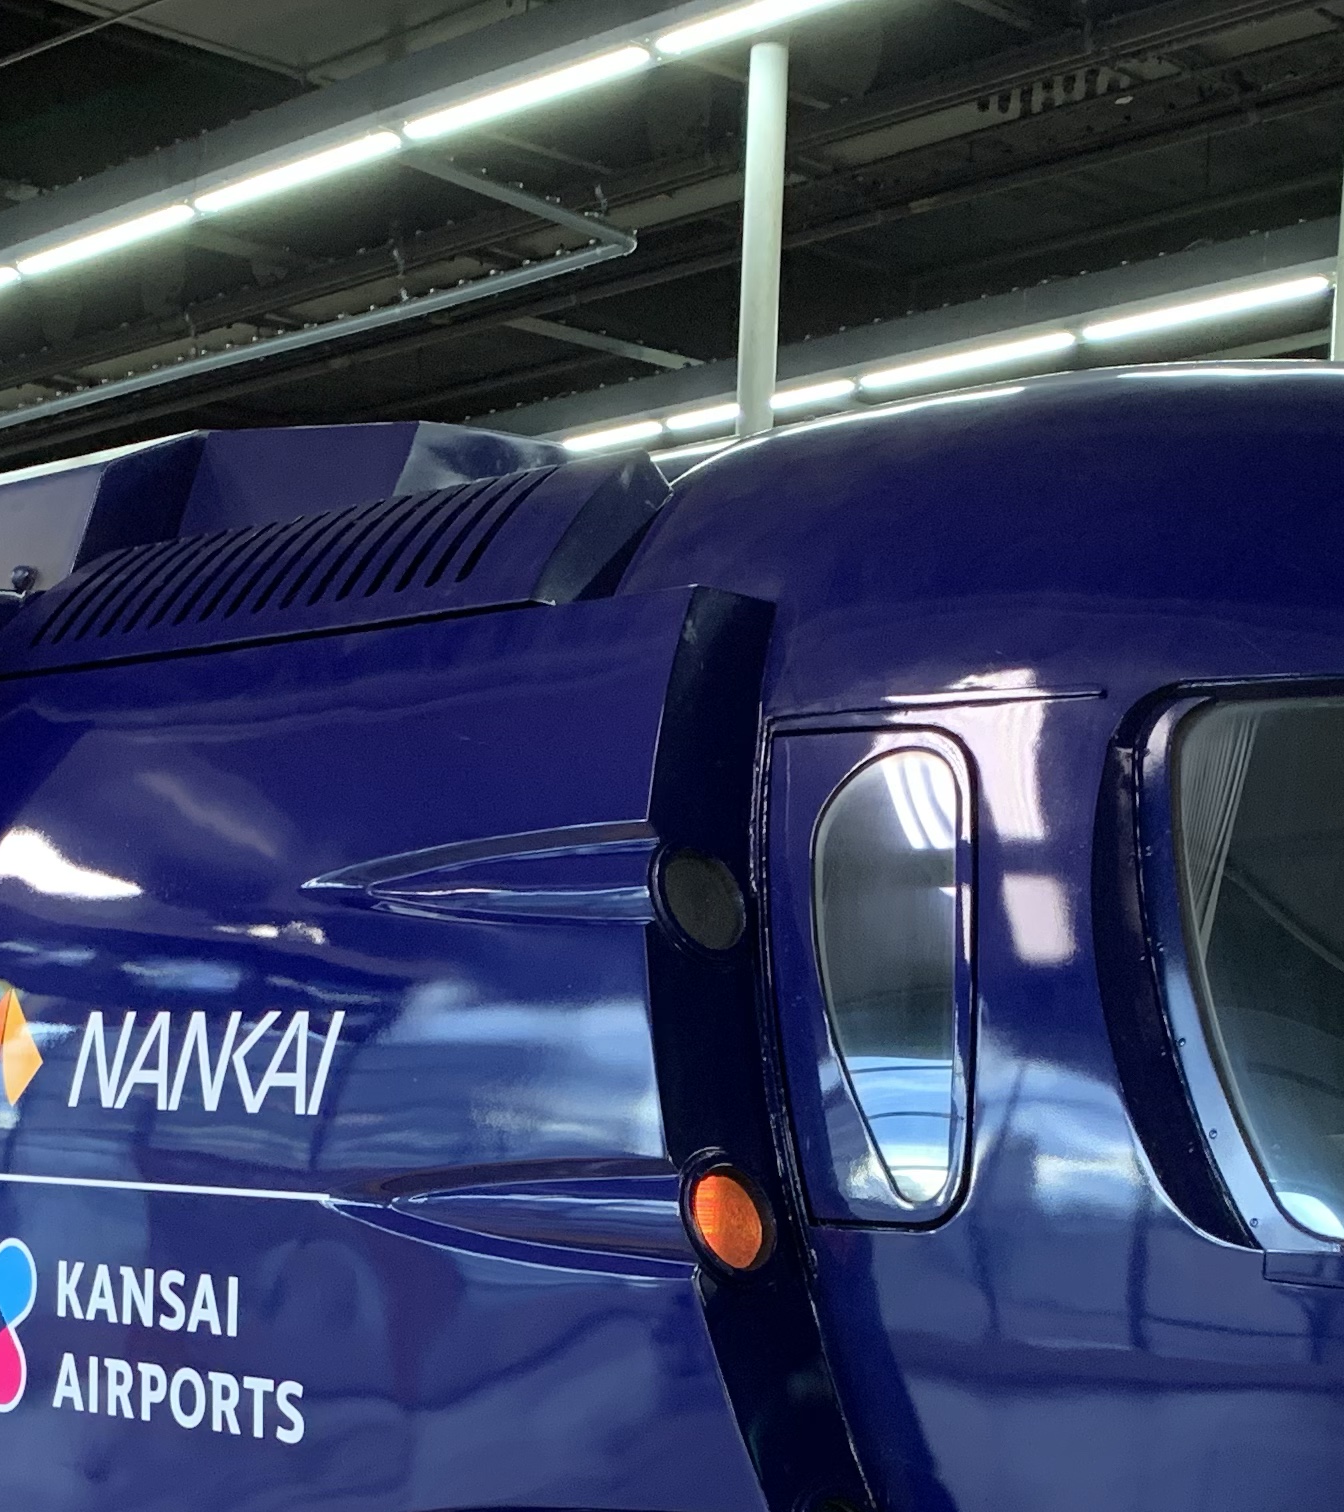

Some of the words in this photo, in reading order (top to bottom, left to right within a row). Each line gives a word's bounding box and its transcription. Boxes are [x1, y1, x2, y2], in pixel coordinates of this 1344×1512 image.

[68, 1010, 346, 1115] NANKAI
[57, 1260, 239, 1337] KANSAI
[52, 1352, 306, 1444] AIRPORTS
